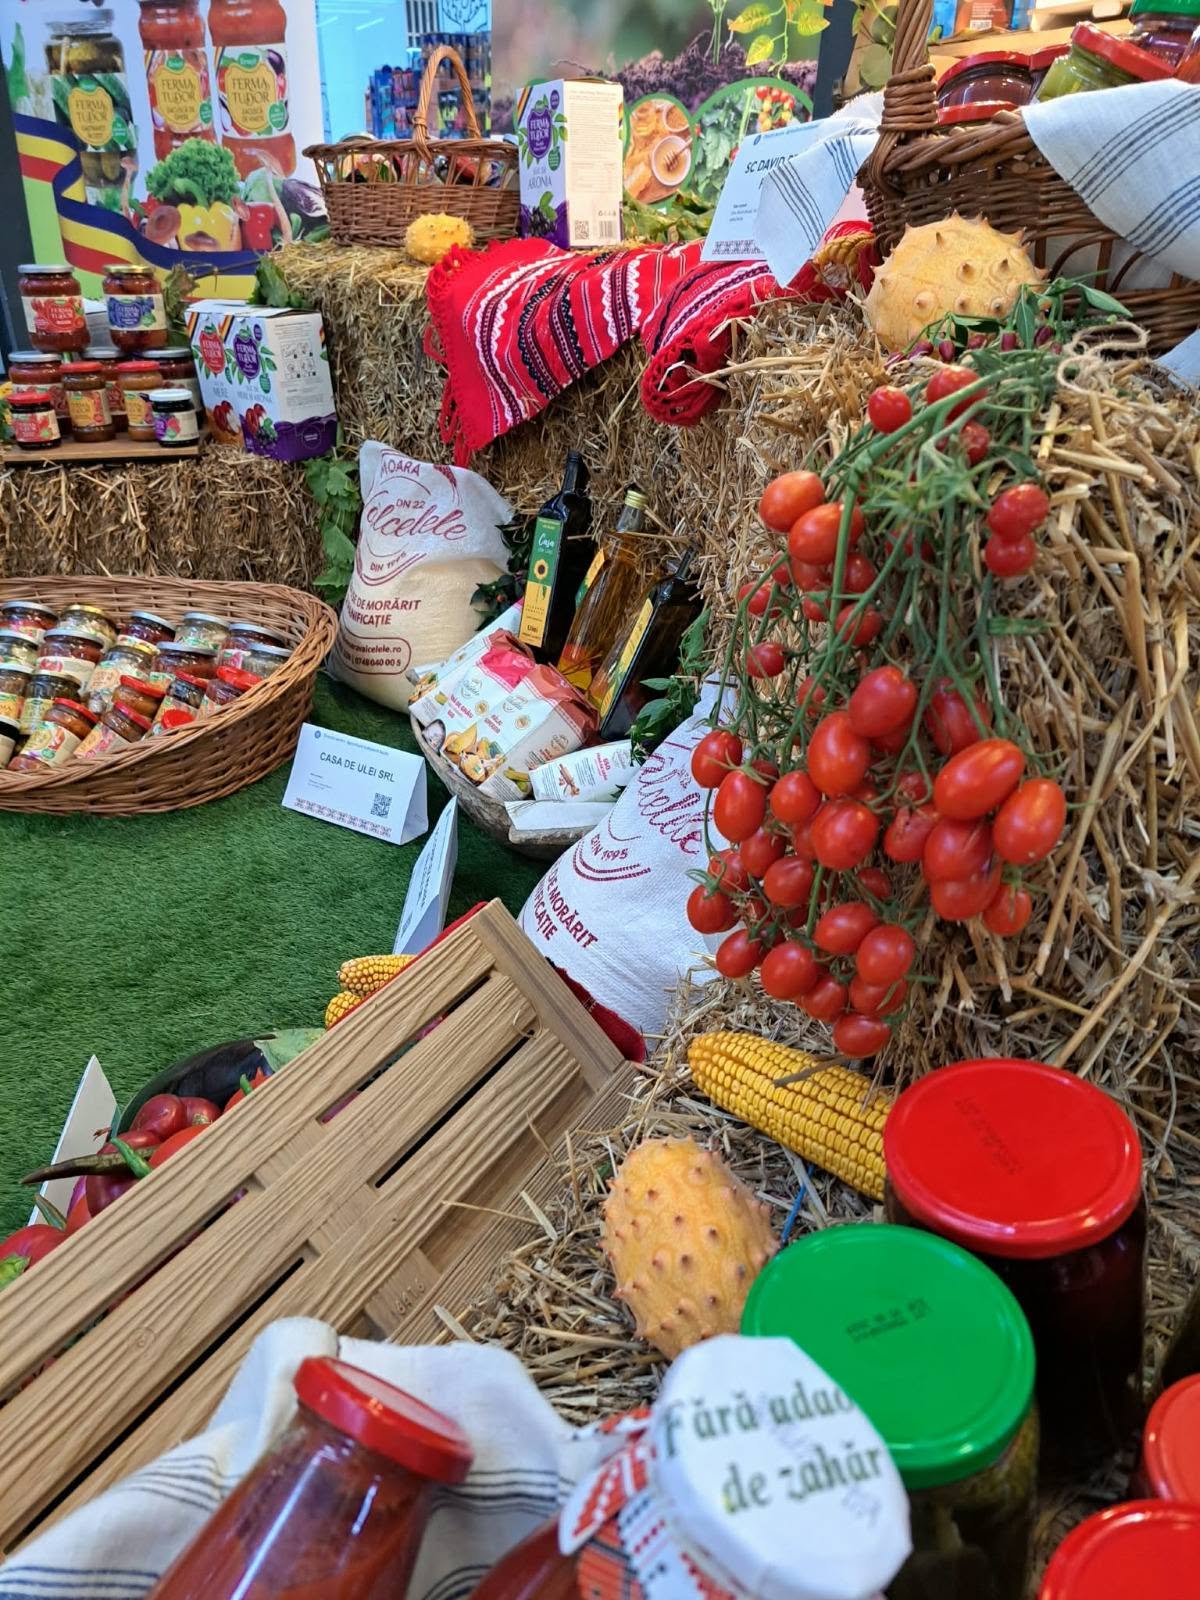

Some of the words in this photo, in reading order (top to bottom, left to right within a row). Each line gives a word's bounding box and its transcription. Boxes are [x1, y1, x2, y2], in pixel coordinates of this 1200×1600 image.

[162, 79, 196, 92] FERMA
[231, 78, 270, 91] FERMA
[232, 91, 270, 105] TUDOR
[366, 597, 422, 611] MORĂRIT
[319, 751, 342, 768] CASA
[344, 759, 356, 771] DE
[357, 761, 377, 777] ULEI
[378, 769, 396, 783] SRL
[548, 885, 599, 948] MORĂRIT
[662, 1391, 759, 1459] Fără
[722, 1463, 773, 1515] de
[779, 1441, 883, 1500] zahăr
